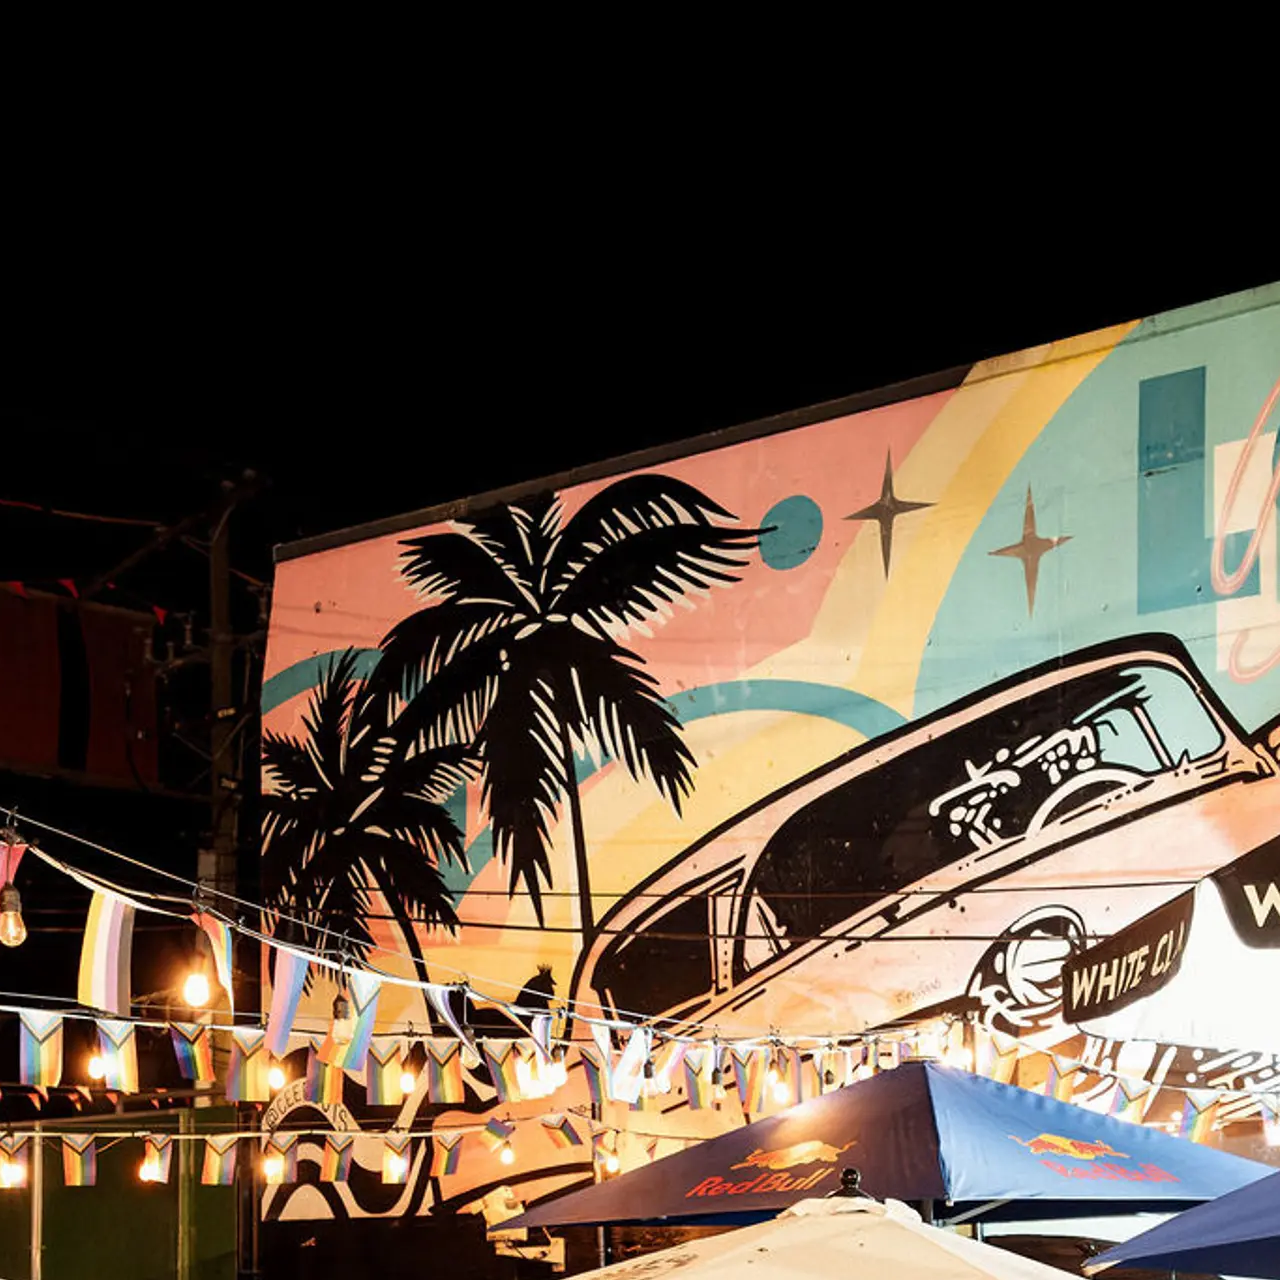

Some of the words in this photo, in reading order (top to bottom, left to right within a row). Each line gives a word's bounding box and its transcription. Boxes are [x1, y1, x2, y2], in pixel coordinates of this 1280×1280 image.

[1071, 944, 1150, 1011] WHITE
[685, 1172, 764, 1198] Red
[758, 1167, 835, 1193] Bull
